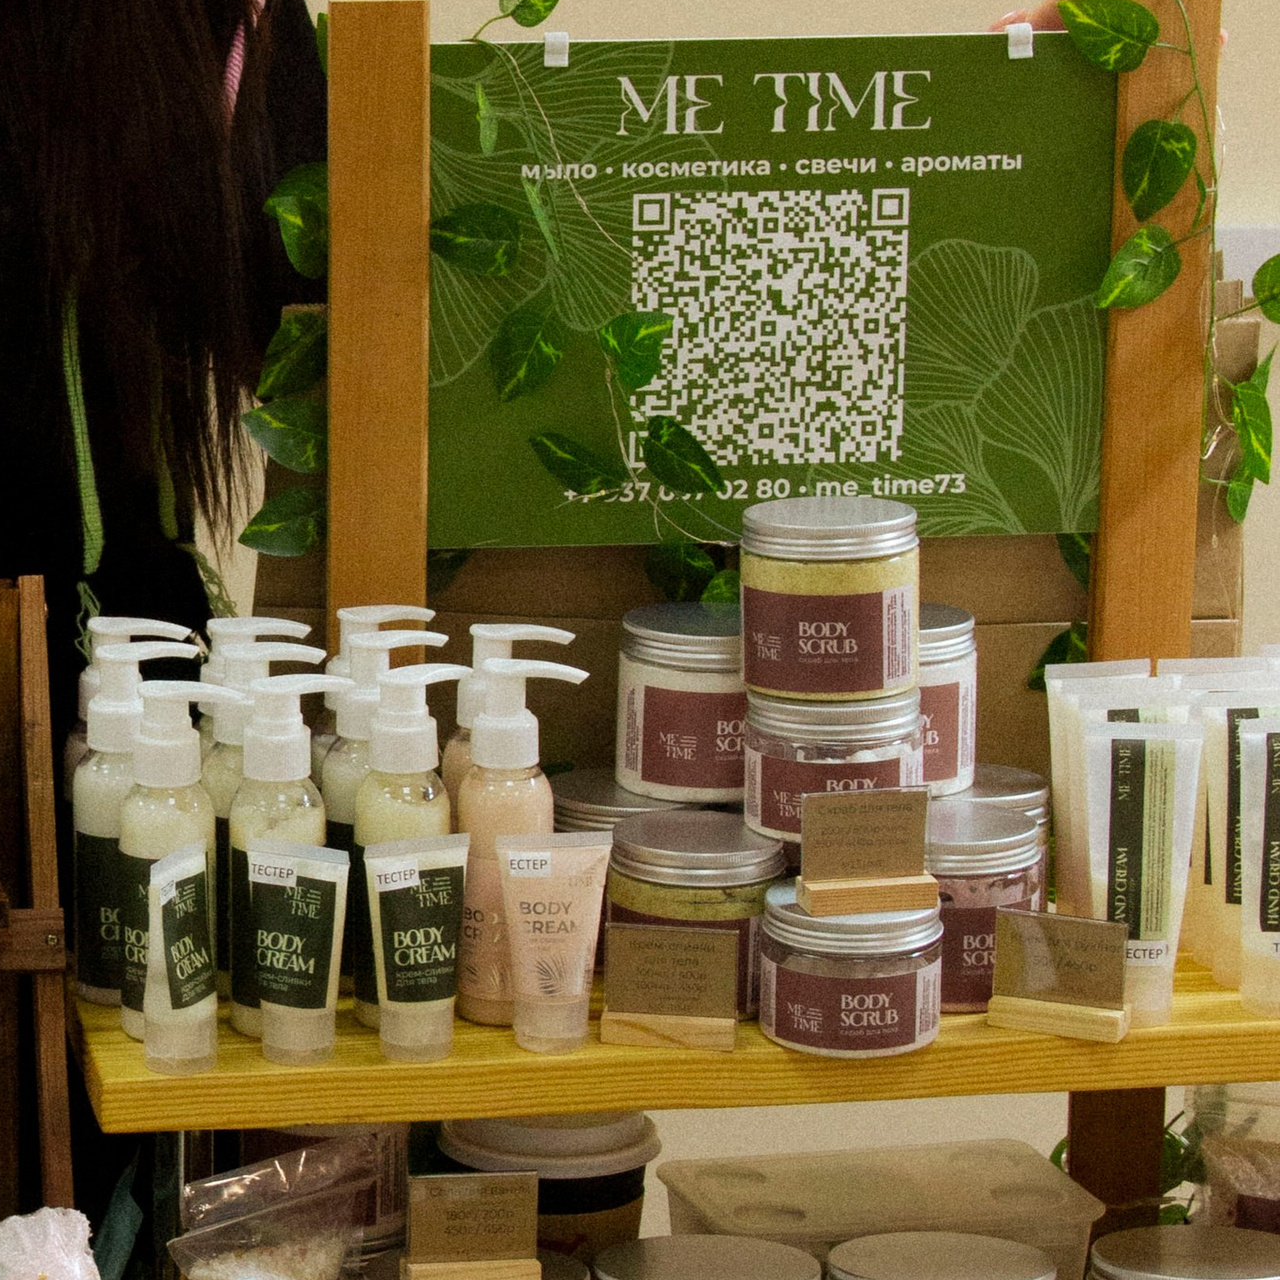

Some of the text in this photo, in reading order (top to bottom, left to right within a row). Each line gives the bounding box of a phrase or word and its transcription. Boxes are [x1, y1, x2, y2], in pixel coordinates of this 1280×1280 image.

[617, 70, 932, 136] ME TIME
[521, 154, 1022, 180] мыло косметика свечи ароматы
[756, 478, 791, 499] 80
[815, 474, 966, 498] me_time73
[799, 622, 851, 637] BODY
[798, 638, 858, 654] SCRUB
[717, 720, 745, 735] BO
[660, 731, 679, 746] ME
[663, 745, 697, 760] TIME
[827, 777, 878, 791] BODY
[251, 863, 294, 879] ТЕСТЕР
[376, 868, 416, 885] ТЕСТЕР
[1114, 847, 1128, 923] AND CREAM
[1267, 841, 1280, 924] HAND CREAM
[284, 886, 307, 901] ME
[415, 890, 453, 908] TIME
[289, 899, 320, 919] TIME
[520, 901, 572, 915] BODY
[124, 926, 149, 947] BO
[257, 929, 306, 954] BODY
[394, 926, 444, 949] BODY
[171, 933, 195, 963] BODY
[394, 943, 456, 966] CREAM
[1126, 947, 1163, 960] ЕСТЕР
[176, 947, 210, 980] CREAM
[257, 948, 315, 974] CREAM
[963, 951, 996, 966] SCR
[787, 1002, 805, 1017] ME
[841, 993, 893, 1010] BODY
[792, 1016, 822, 1033] TIME
[840, 1009, 898, 1027] SCRUB
